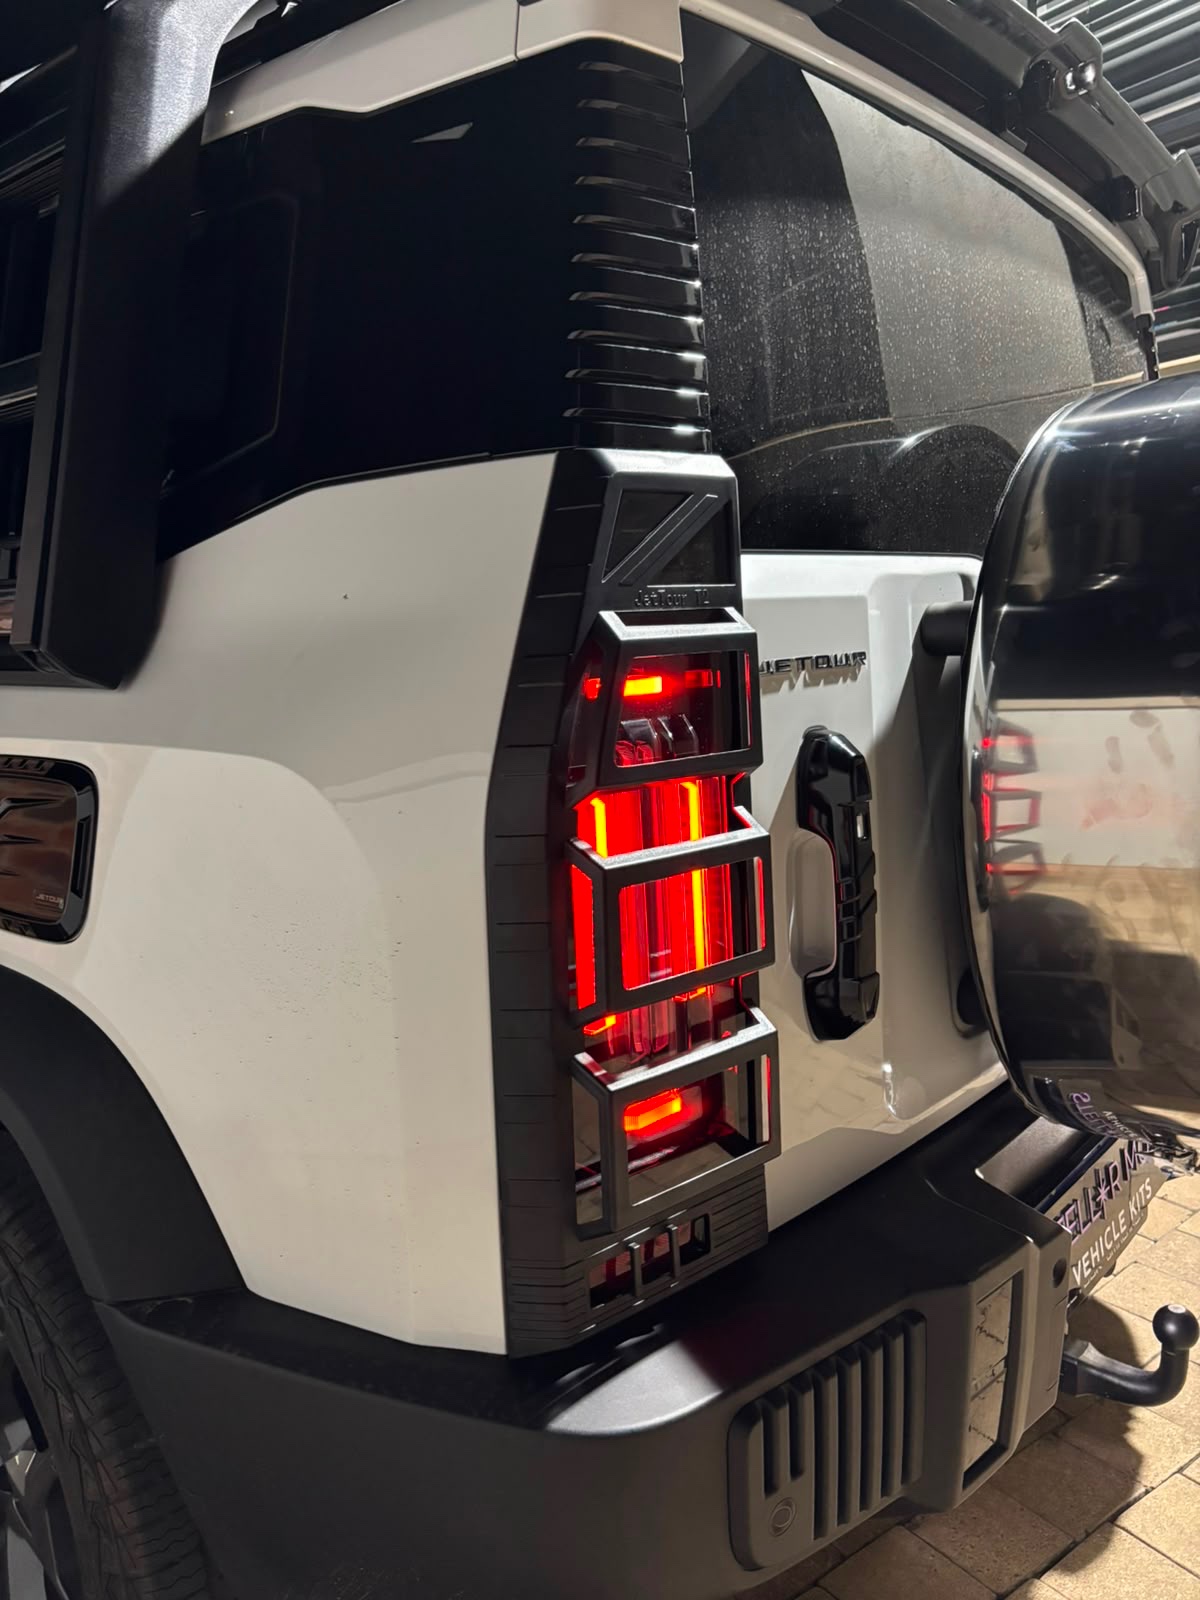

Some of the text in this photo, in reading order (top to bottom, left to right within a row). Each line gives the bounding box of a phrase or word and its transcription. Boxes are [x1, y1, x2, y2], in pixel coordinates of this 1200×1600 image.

[759, 651, 867, 674] JETOUR
[1072, 1209, 1126, 1286] VEHICLE
[1129, 1177, 1153, 1222] KITS
